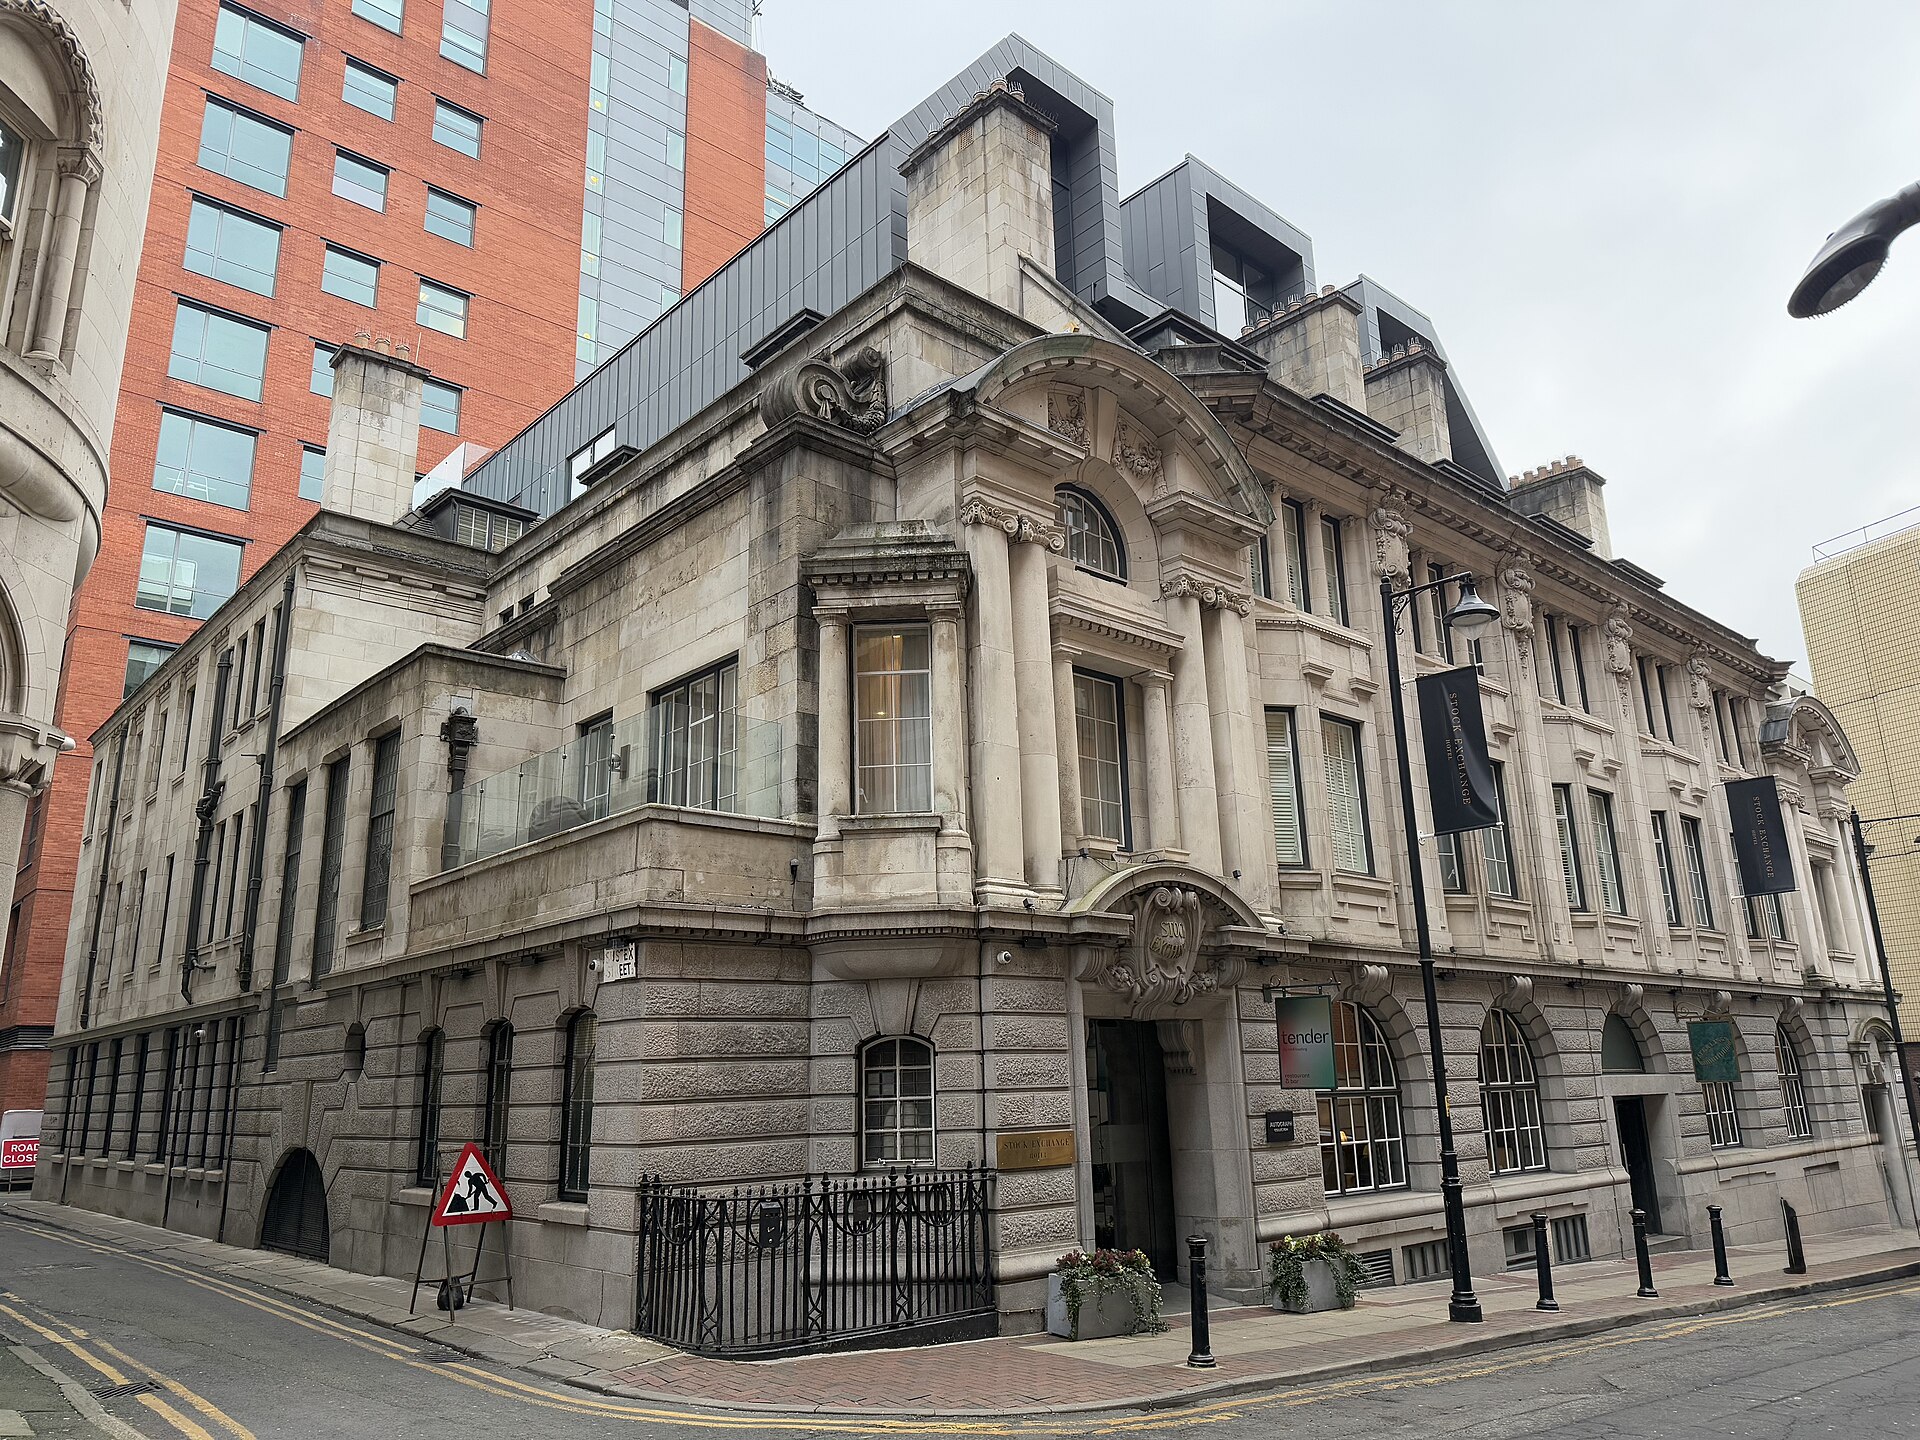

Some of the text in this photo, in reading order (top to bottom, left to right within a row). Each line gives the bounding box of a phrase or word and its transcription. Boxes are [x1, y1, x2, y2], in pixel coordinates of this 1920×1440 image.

[1449, 693, 1471, 805] STOCK EXCHANGE
[1752, 796, 1774, 878] STOCK EXCHANGE
[1160, 921, 1186, 938] STOC
[1281, 1028, 1329, 1044] tender
[11, 1143, 40, 1152] ROAD
[1003, 1138, 1070, 1150] STOCK EXCHANGE
[3, 1153, 38, 1163] CLOSE
